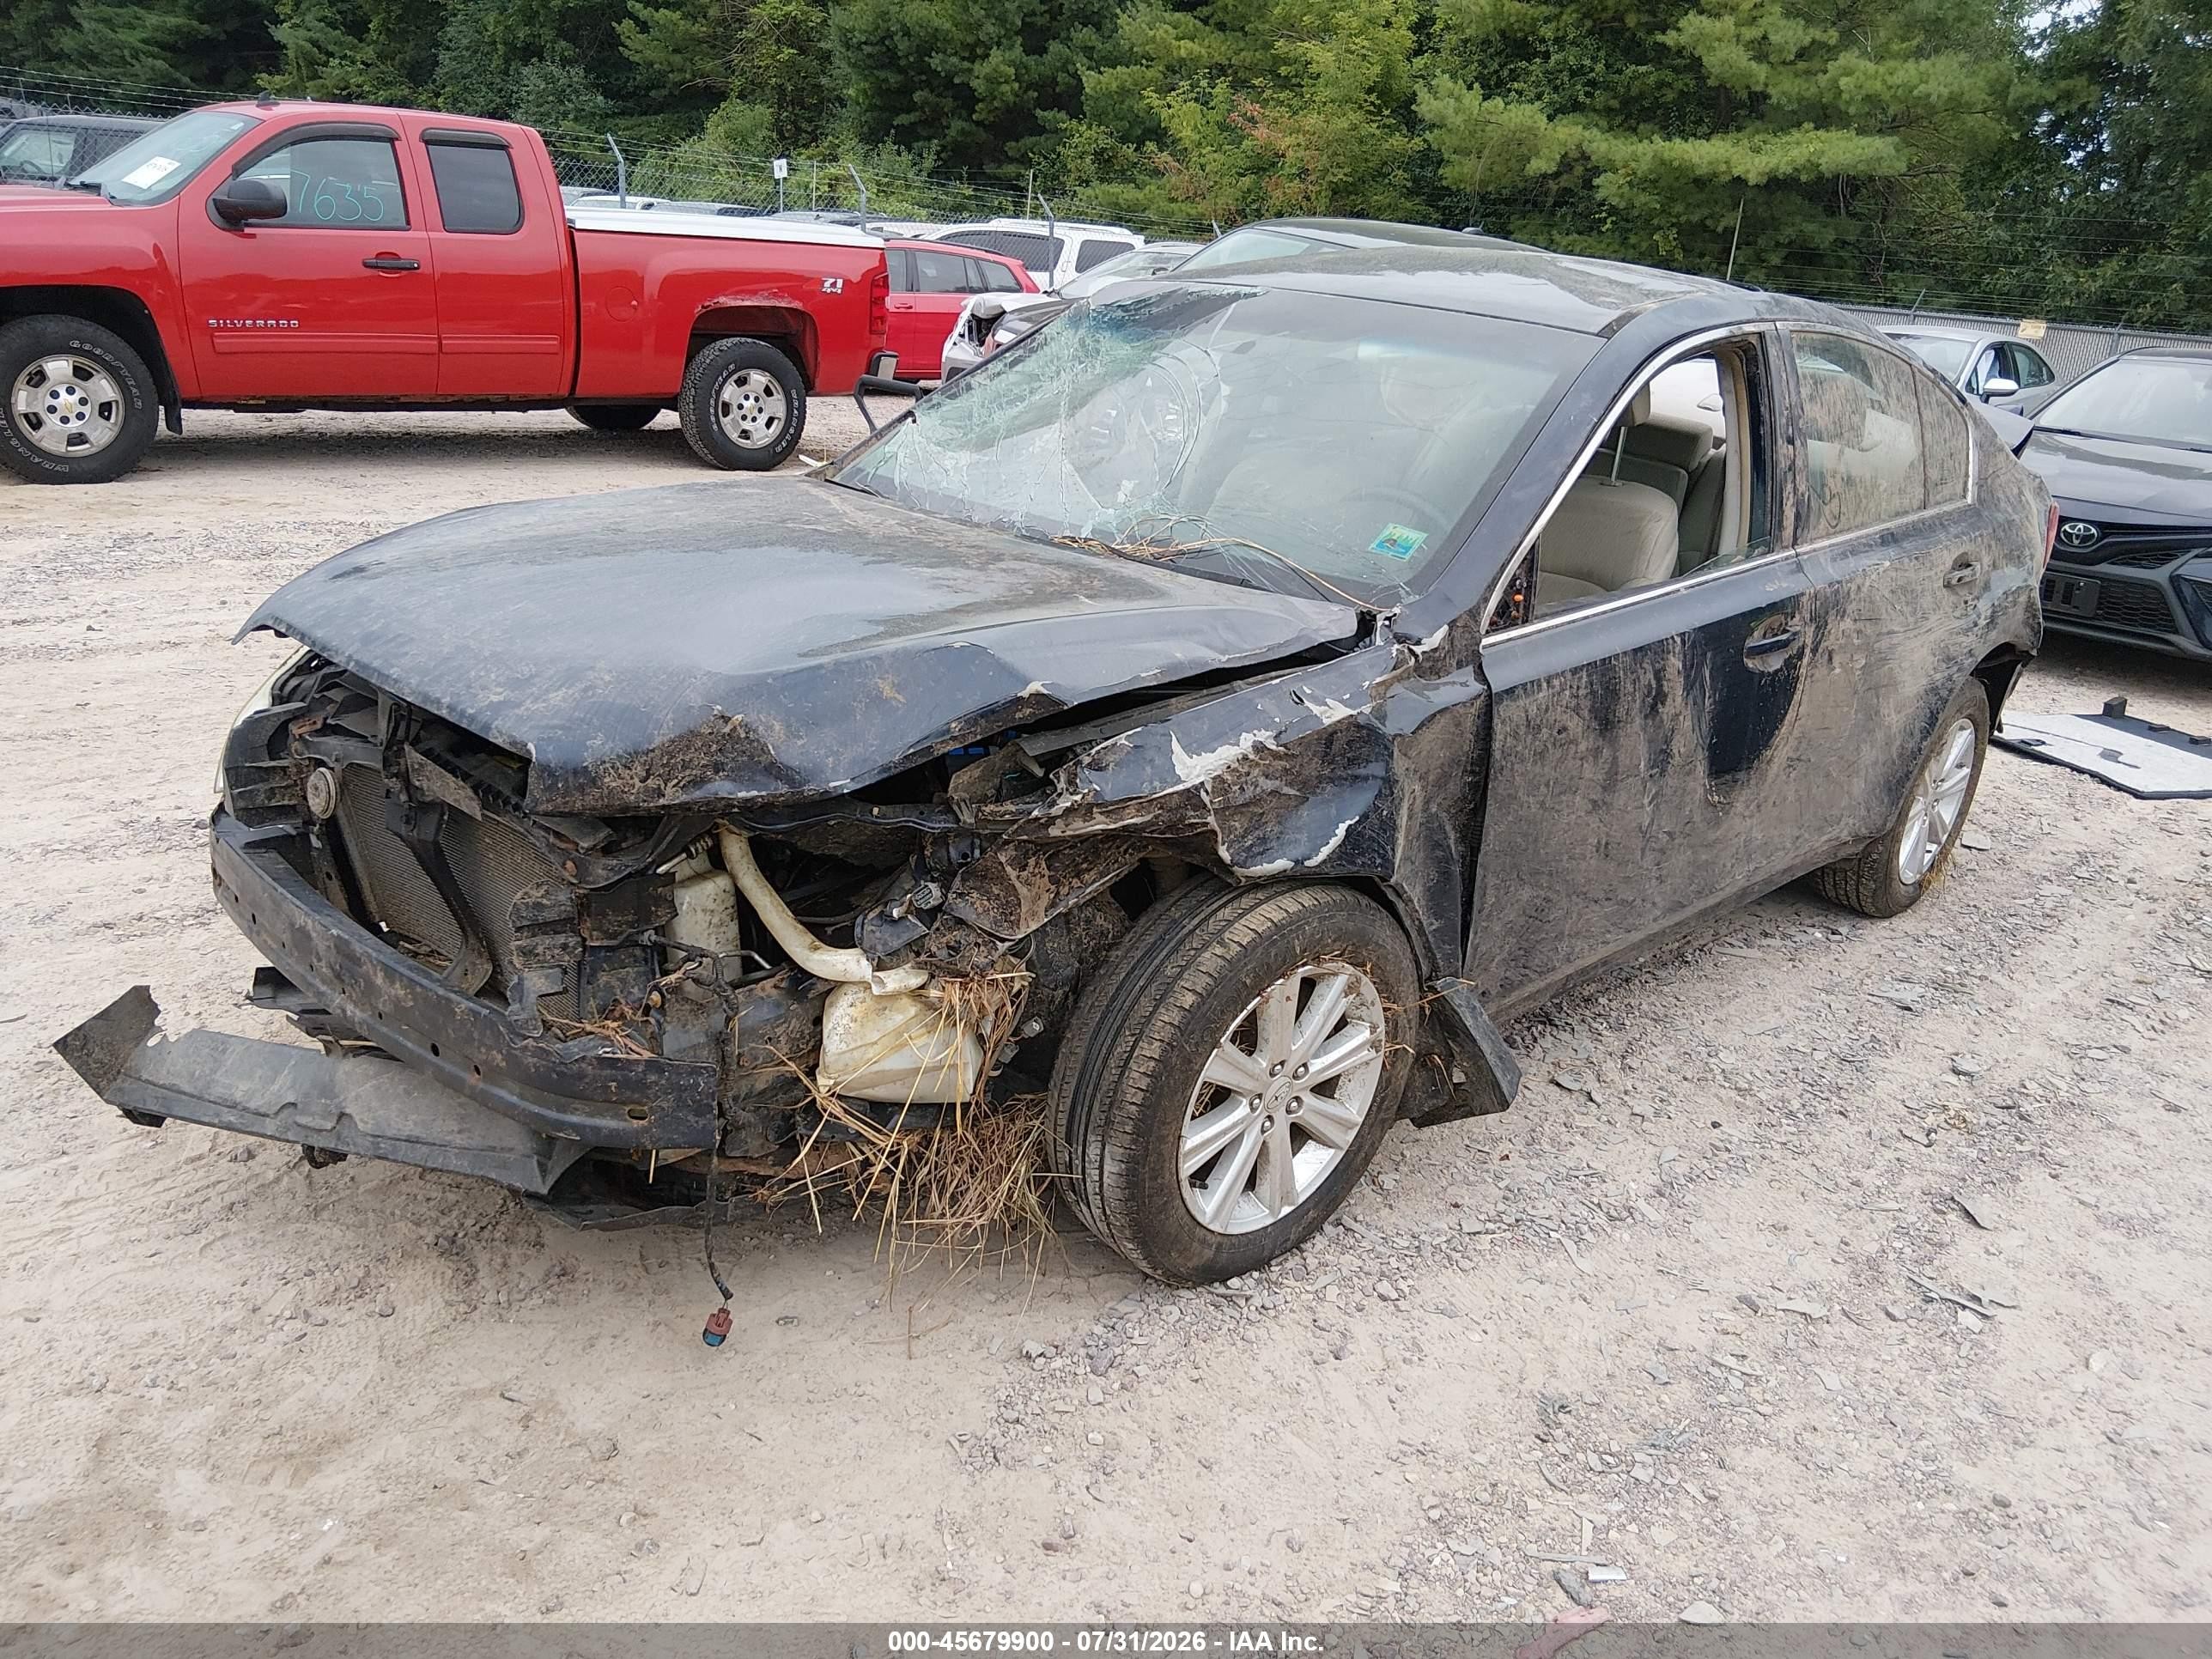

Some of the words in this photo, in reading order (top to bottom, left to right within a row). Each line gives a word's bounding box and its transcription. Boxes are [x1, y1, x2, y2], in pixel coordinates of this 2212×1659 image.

[291, 168, 384, 221] 7635
[208, 319, 299, 328] SILVERADO
[70, 340, 143, 410] GOODYEAR
[709, 362, 736, 432] GOODYEAR
[775, 388, 799, 453] WRANGLER
